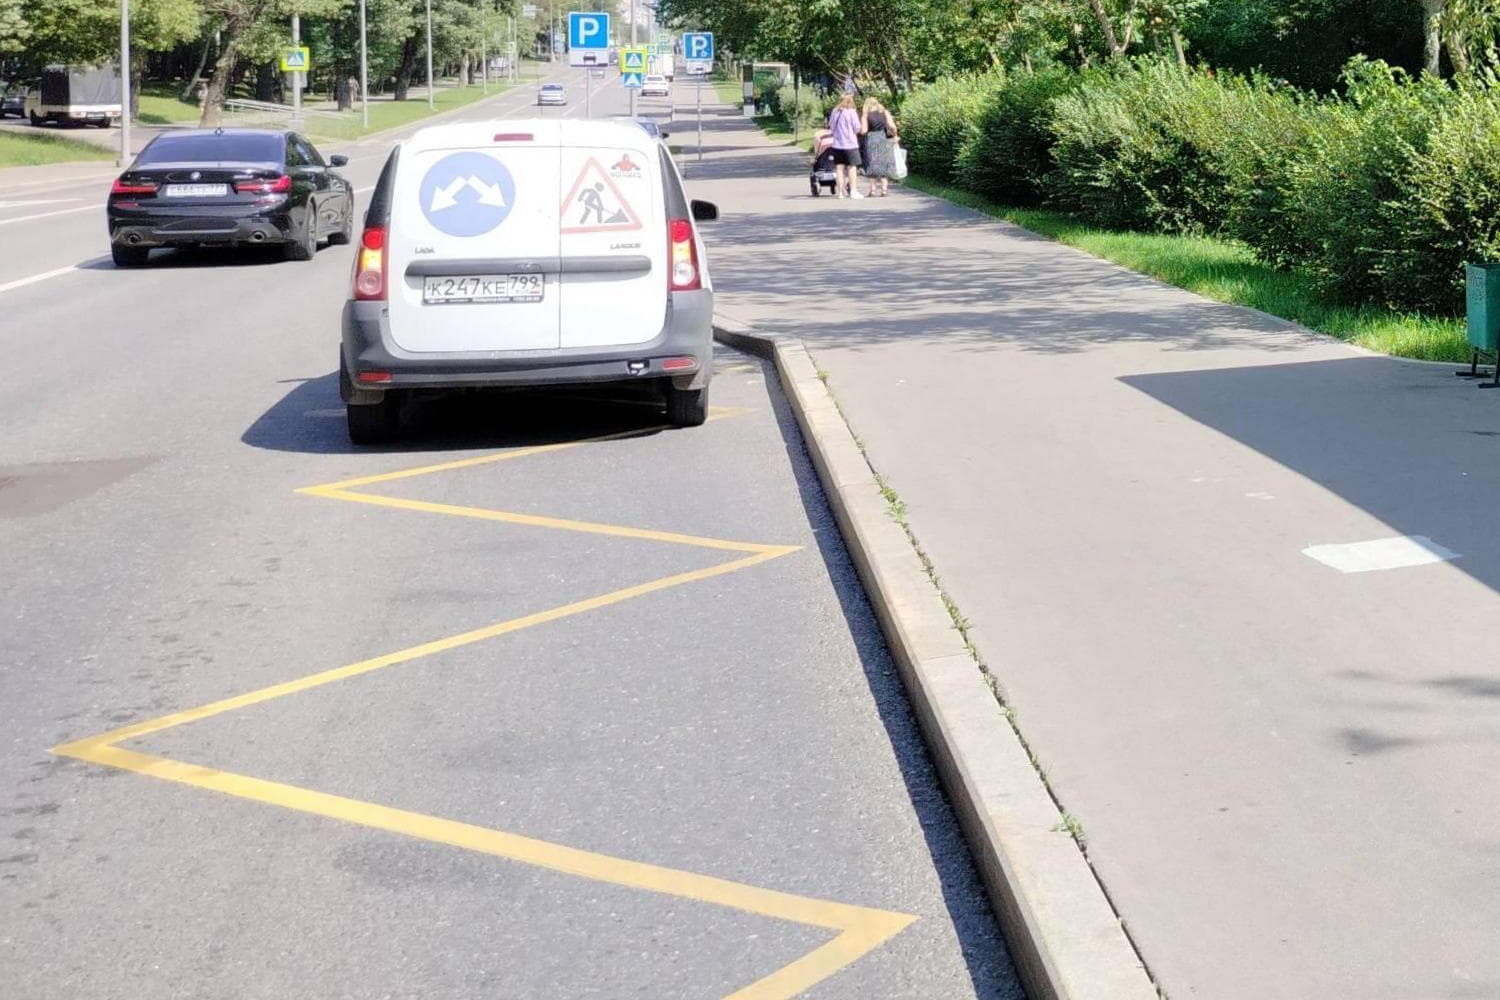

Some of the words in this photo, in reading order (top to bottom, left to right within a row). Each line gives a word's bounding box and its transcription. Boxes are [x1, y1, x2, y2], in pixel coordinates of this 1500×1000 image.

[579, 18, 600, 45] P
[691, 36, 708, 58] P
[414, 247, 435, 255] LADA
[432, 278, 506, 296] К247КЕ
[511, 275, 538, 290] 799
